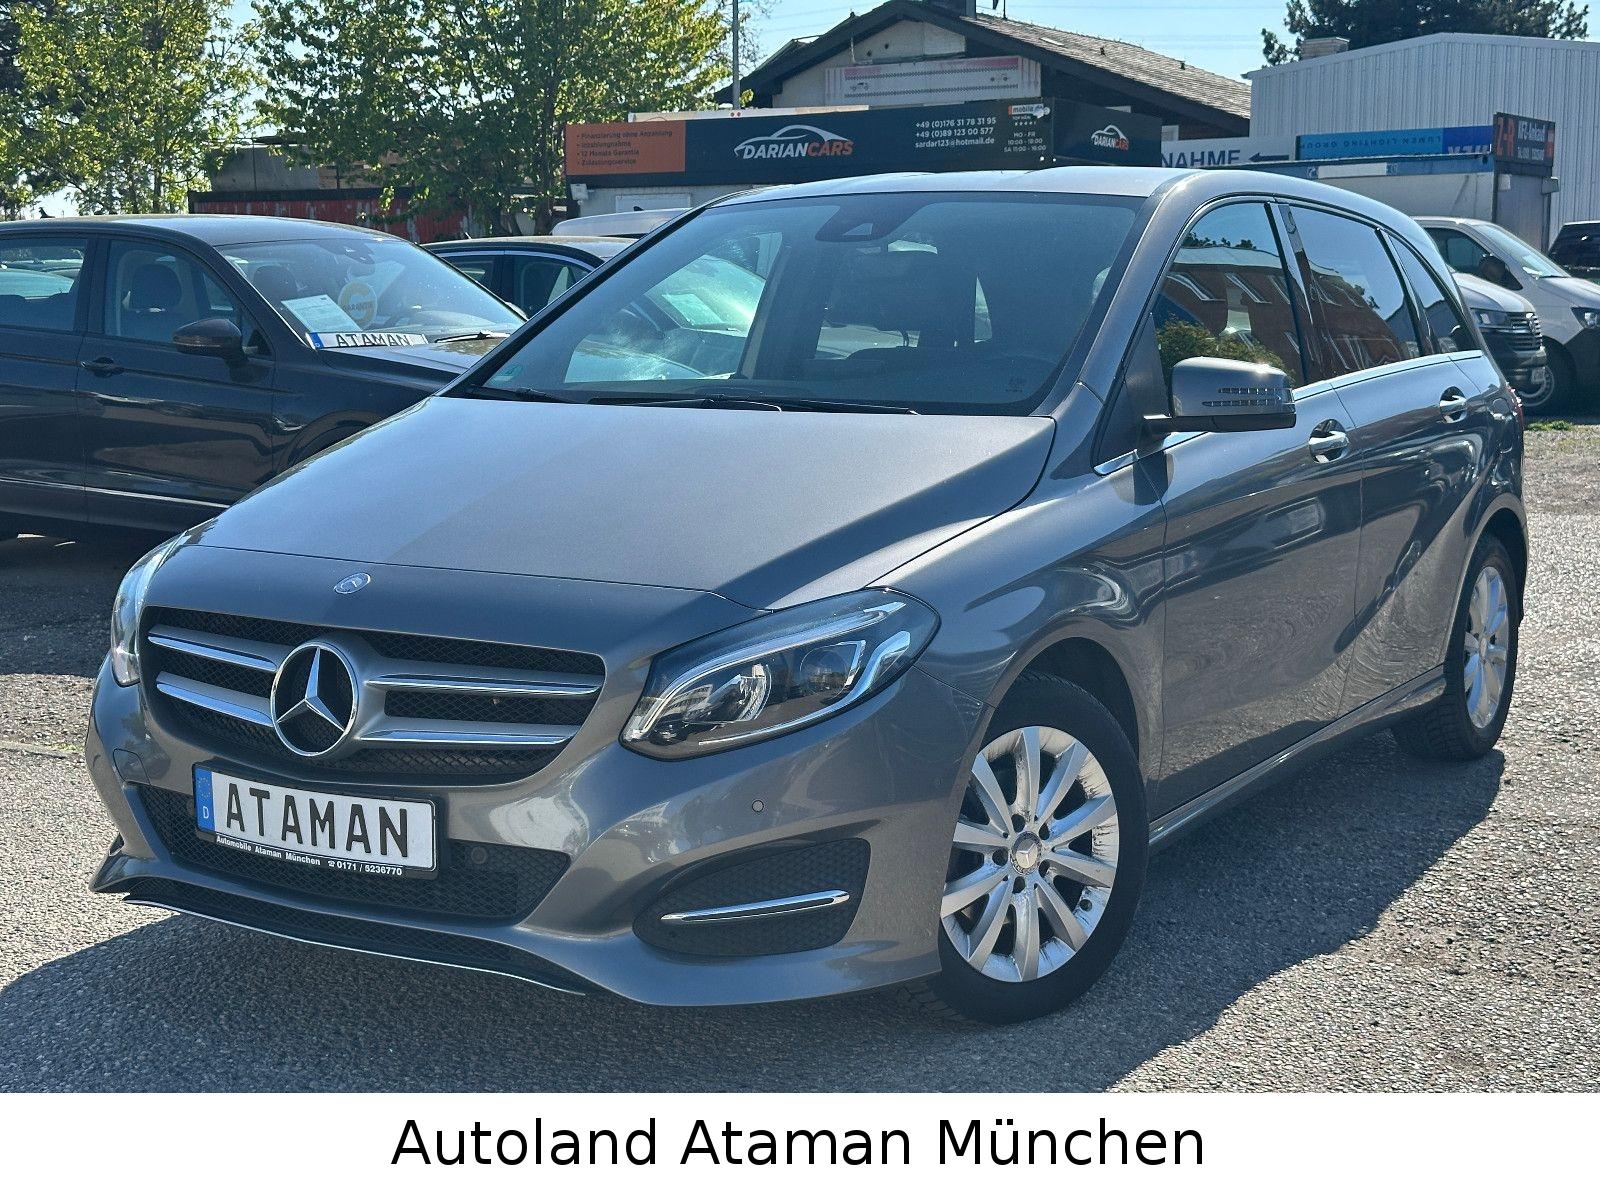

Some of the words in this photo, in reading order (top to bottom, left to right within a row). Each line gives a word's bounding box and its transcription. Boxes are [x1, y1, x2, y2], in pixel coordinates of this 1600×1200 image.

[956, 118, 965, 126] 31
[966, 118, 975, 126] 78
[977, 117, 985, 125] 31
[986, 116, 997, 125] 95
[915, 130, 930, 138] +49
[931, 129, 952, 138] (0)89
[953, 128, 966, 136] 123
[980, 126, 994, 135] 577
[742, 139, 855, 160] DARIANCARS
[335, 333, 414, 347] ATAMAN
[202, 805, 210, 819] D
[226, 782, 408, 858] ATAMAN
[216, 835, 252, 852] Automobile
[254, 846, 282, 858] Ataman
[285, 851, 321, 865] München
[336, 860, 357, 871] 0171
